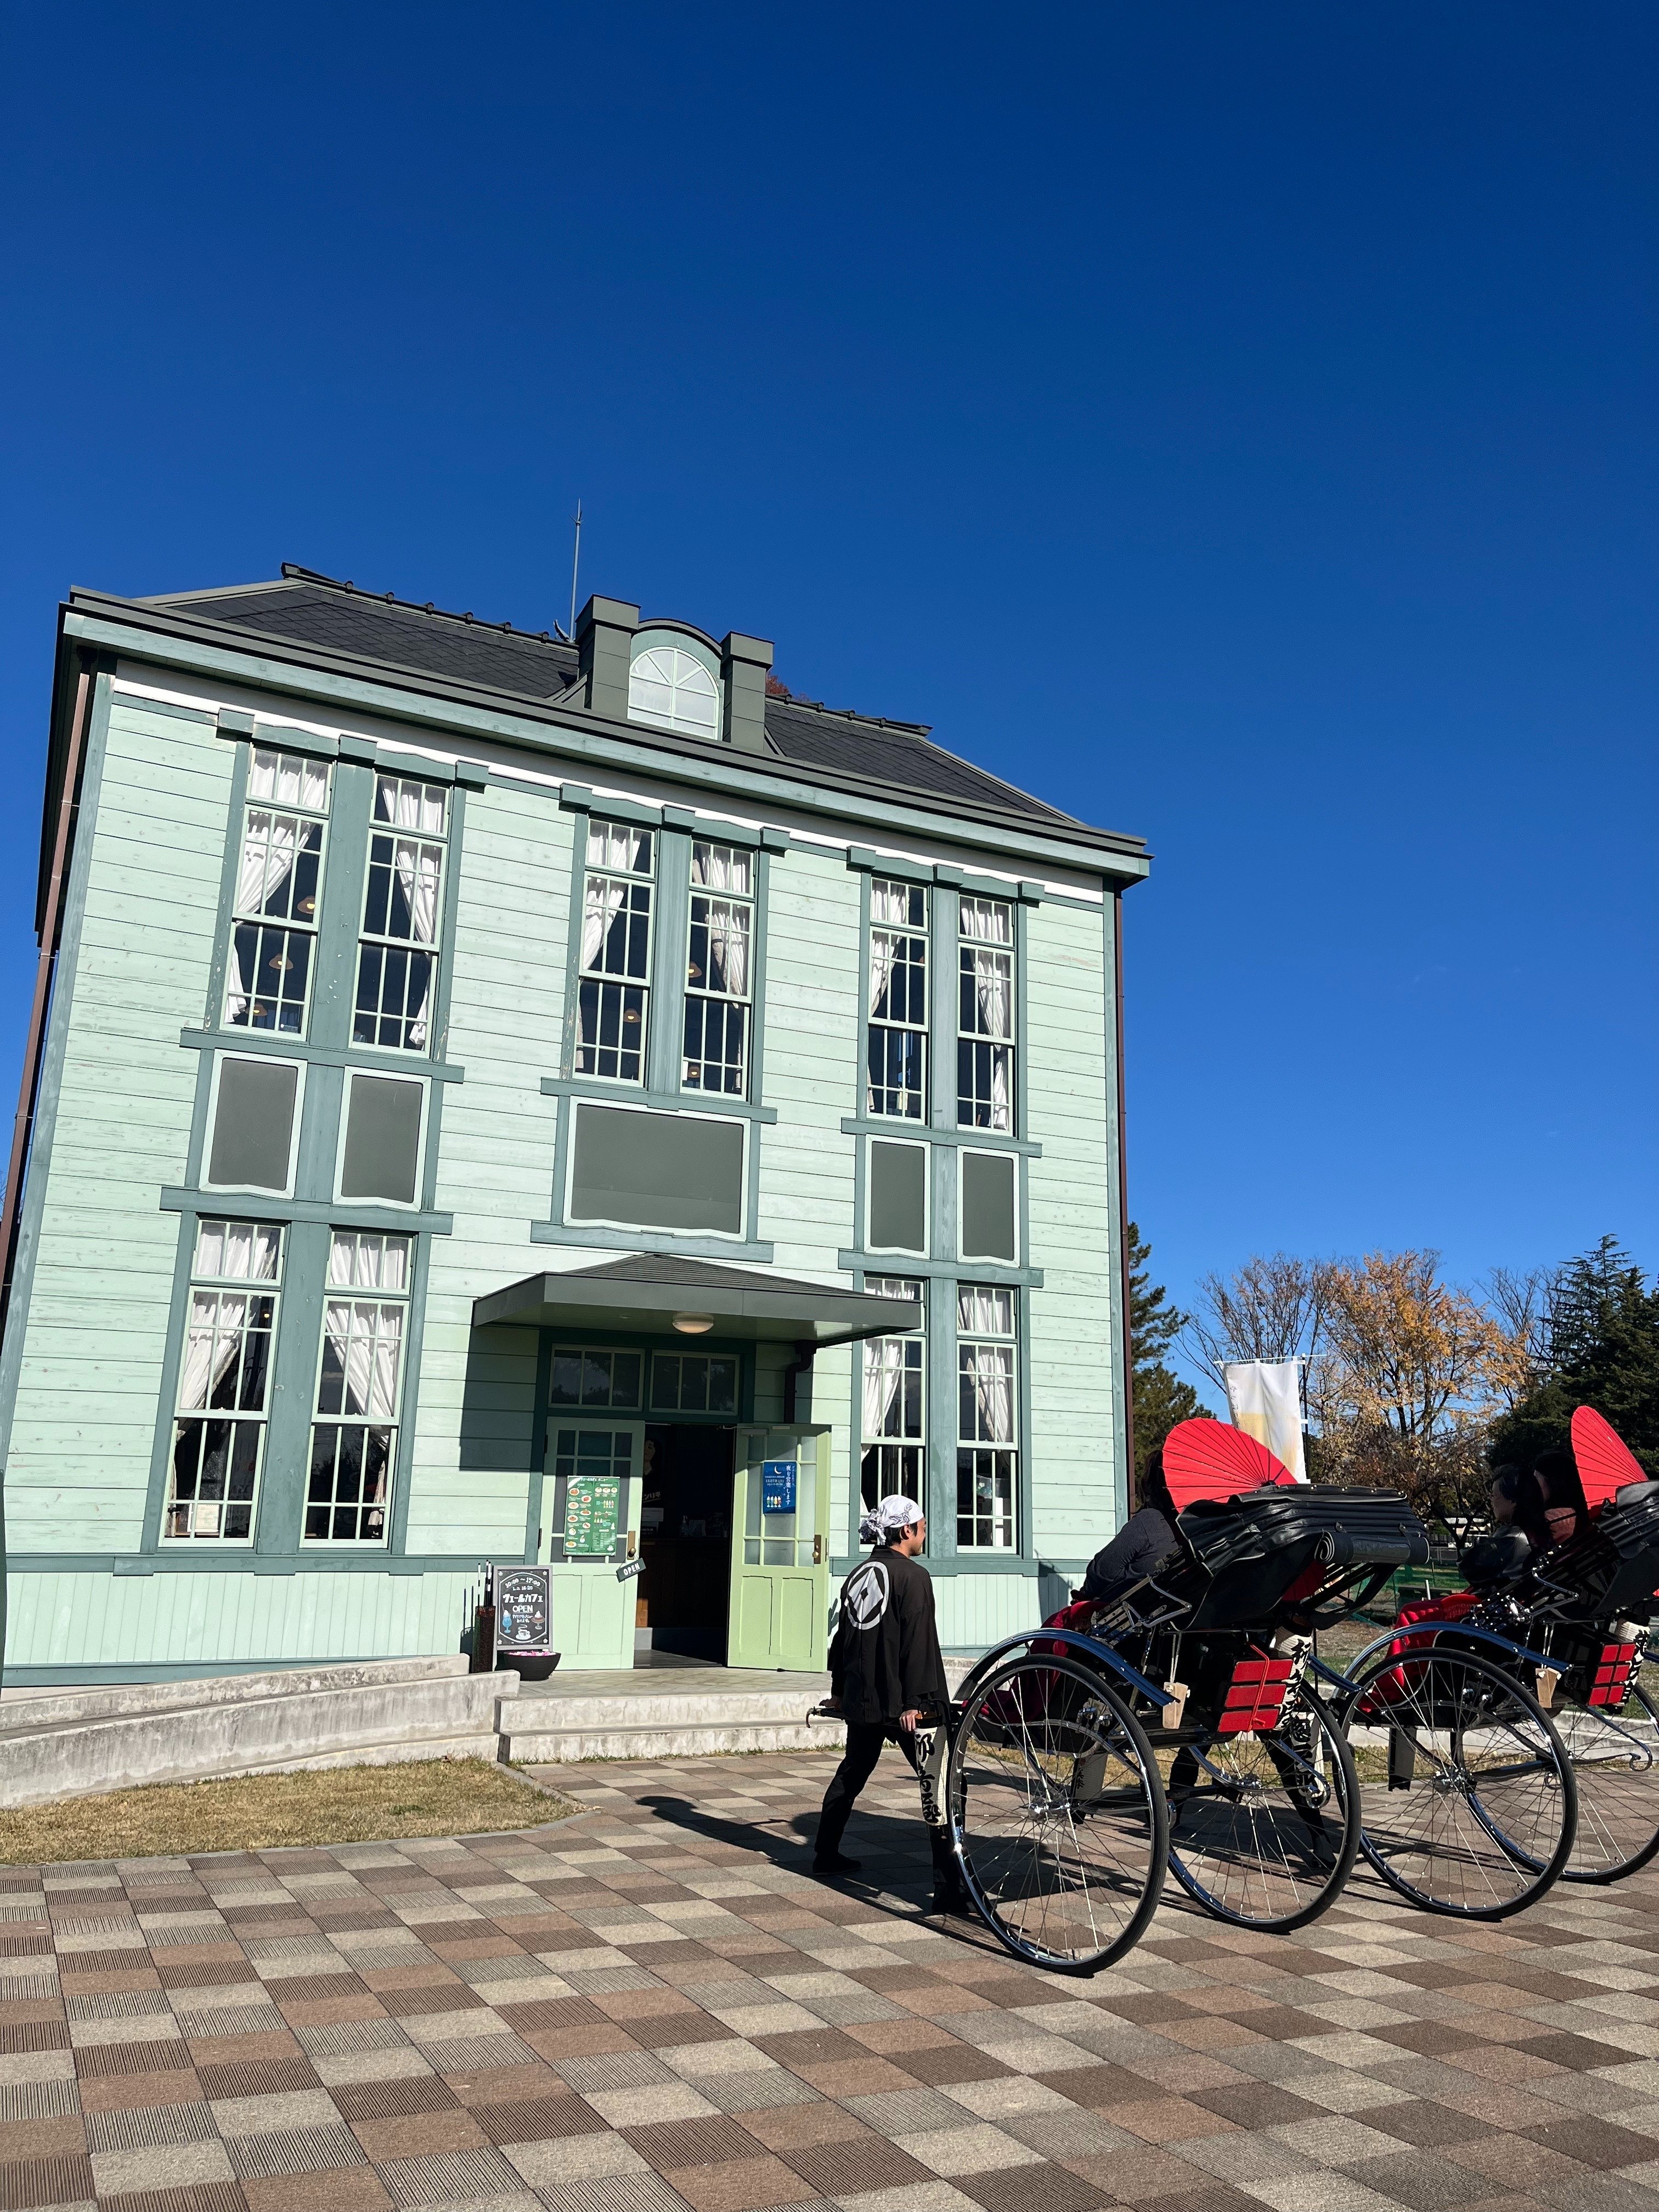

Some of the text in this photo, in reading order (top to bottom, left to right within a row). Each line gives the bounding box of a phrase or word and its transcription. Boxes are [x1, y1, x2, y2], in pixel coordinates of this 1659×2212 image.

[623, 1563, 640, 1576] OPEN
[505, 1578, 519, 1588] 10:00
[526, 1577, 540, 1586] 17:00
